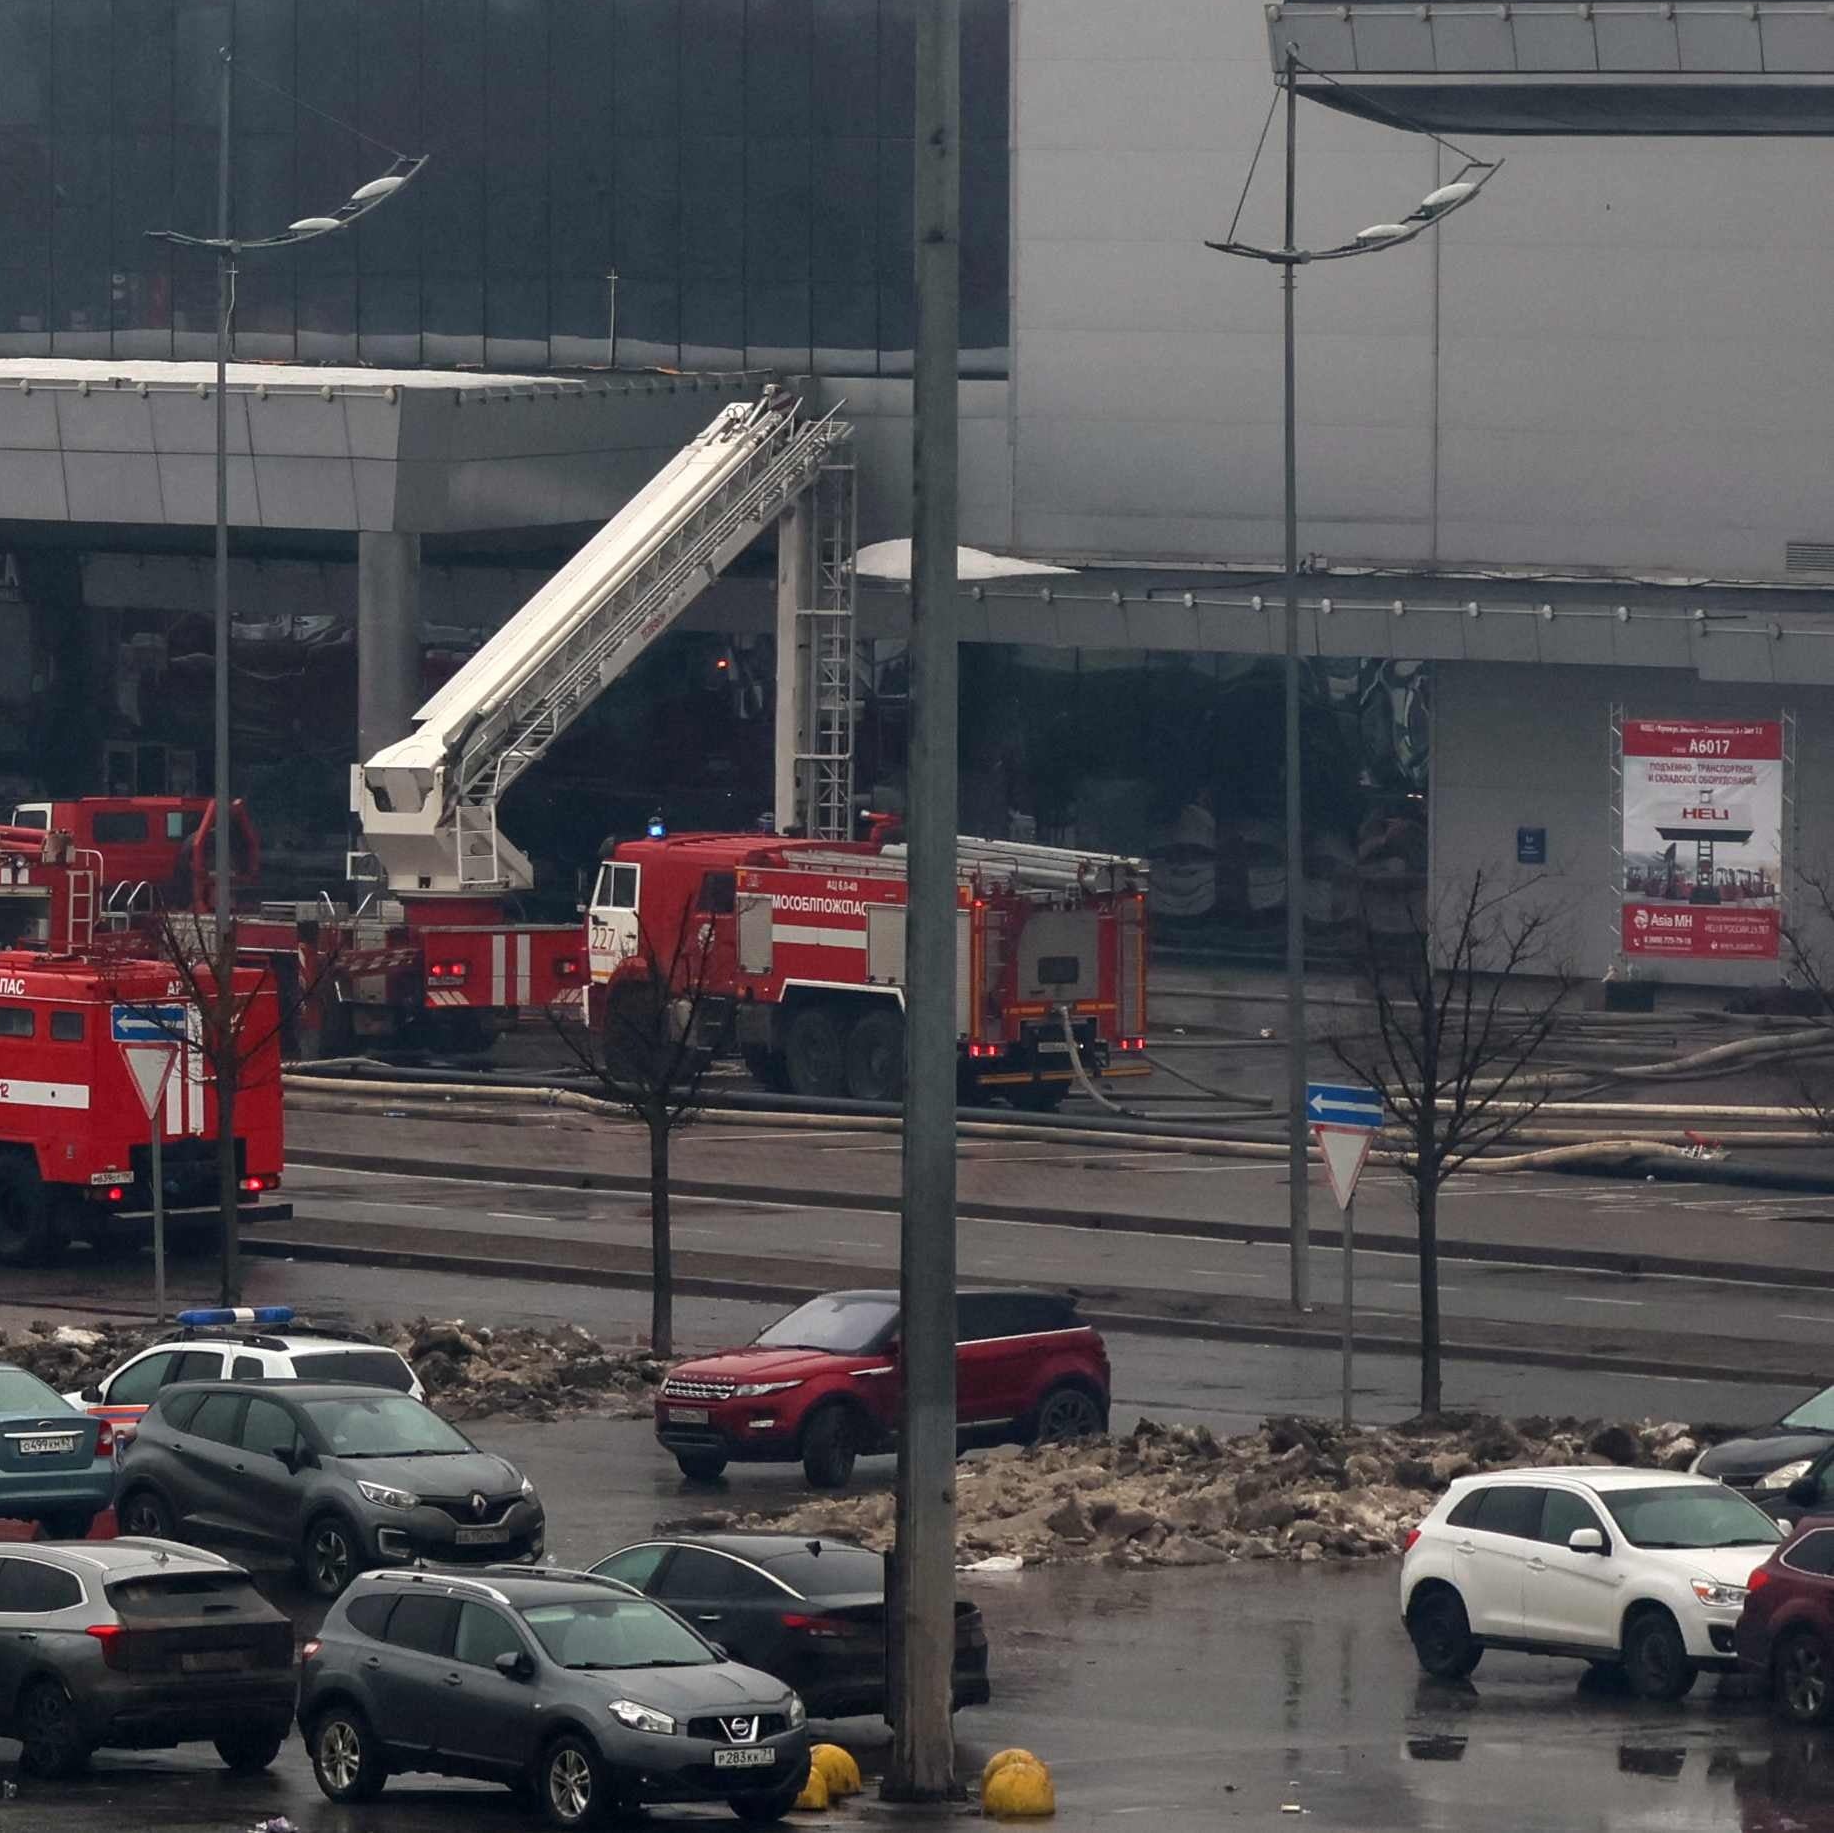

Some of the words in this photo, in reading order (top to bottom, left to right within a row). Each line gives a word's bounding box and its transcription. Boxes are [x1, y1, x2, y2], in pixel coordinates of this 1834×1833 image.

[1689, 738, 1730, 755] A6017
[1683, 808, 1729, 820] HELI
[772, 894, 866, 917] МОСОБЛПОЖСПАС
[1650, 913, 1673, 927] Asia
[591, 927, 615, 951] 227
